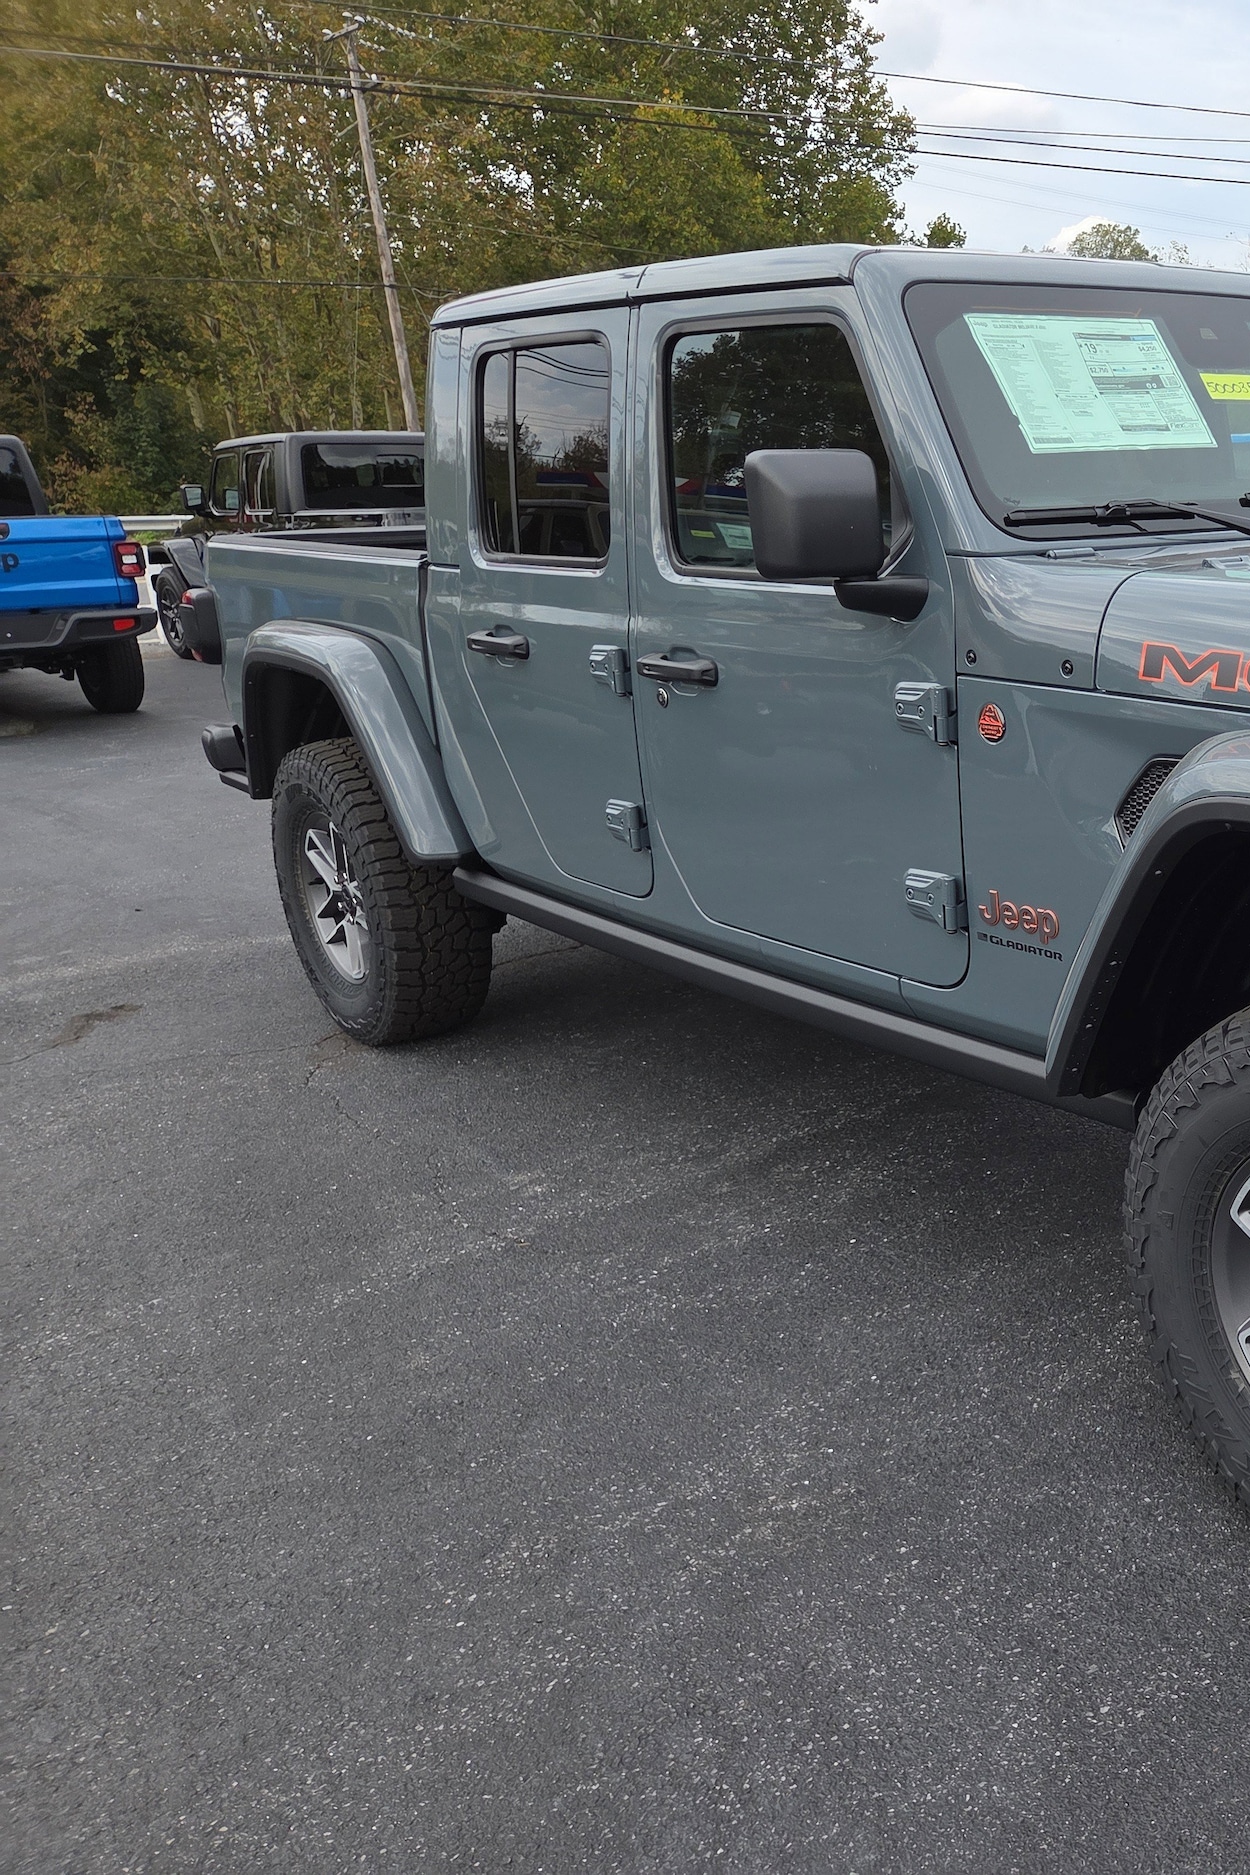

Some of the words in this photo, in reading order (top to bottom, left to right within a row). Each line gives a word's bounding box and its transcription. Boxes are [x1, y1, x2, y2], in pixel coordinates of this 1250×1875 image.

[1084, 343, 1098, 354] 19
[978, 889, 1060, 946] Jeep
[989, 934, 1064, 962] GLADIATOR
